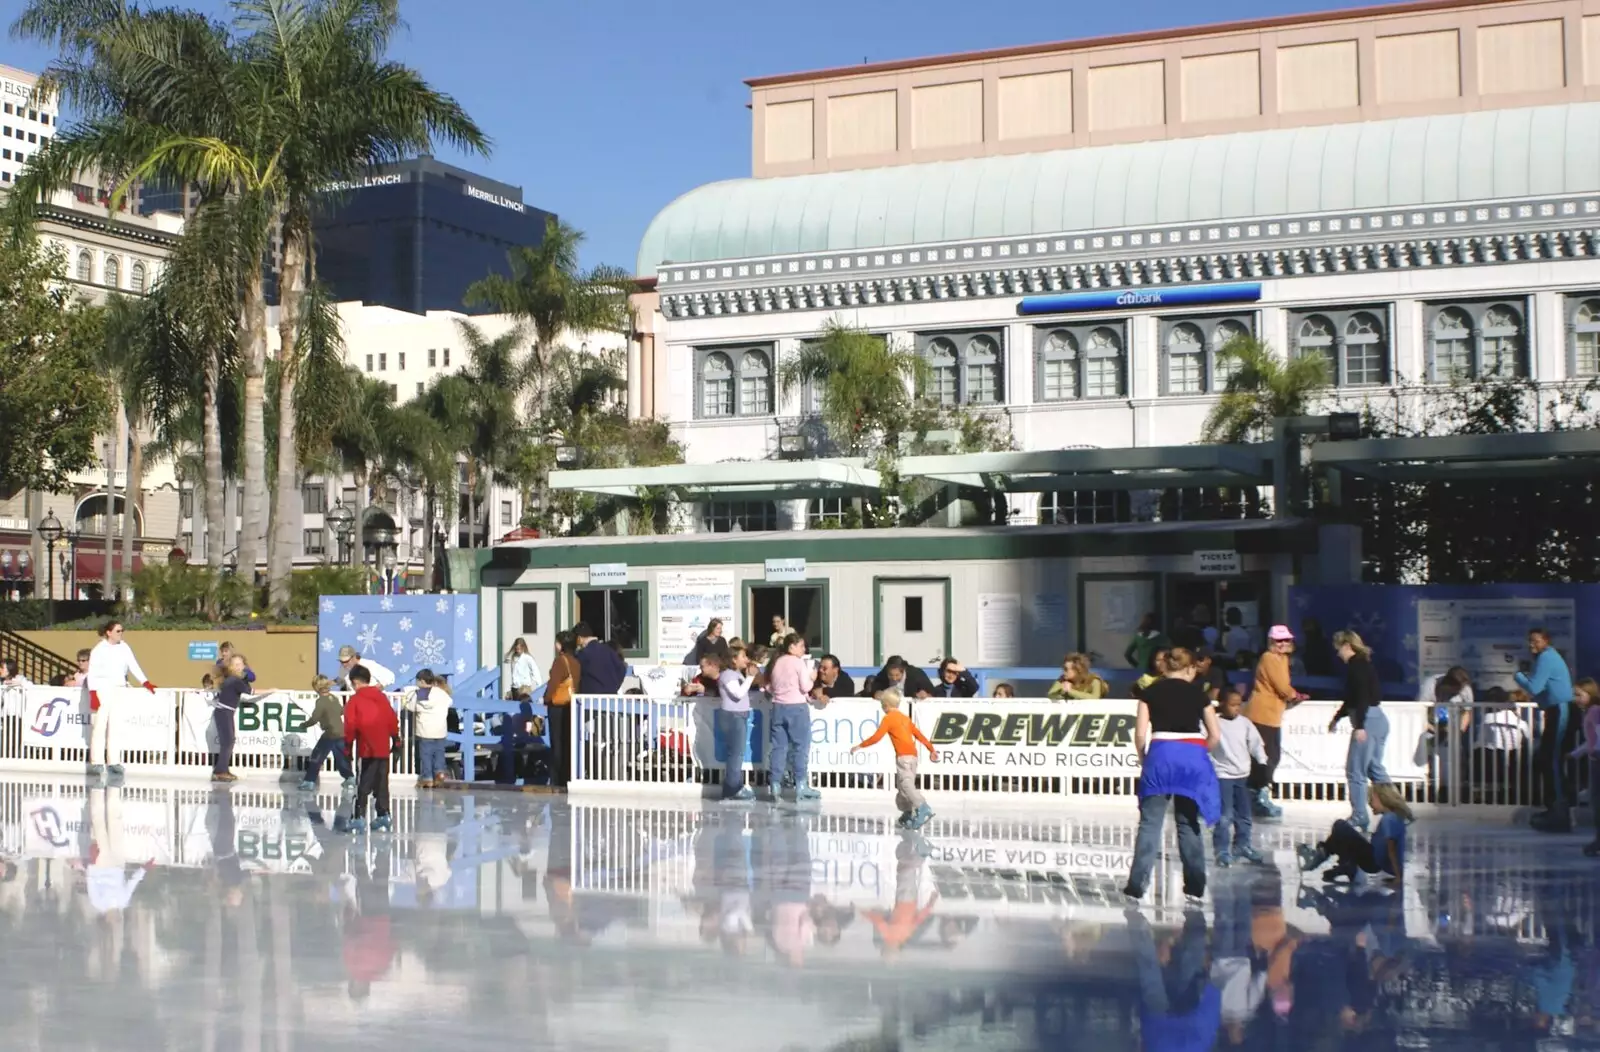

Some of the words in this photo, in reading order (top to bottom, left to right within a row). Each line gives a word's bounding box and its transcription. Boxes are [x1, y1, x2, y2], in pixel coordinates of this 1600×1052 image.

[364, 174, 401, 187] LYNCH
[467, 185, 499, 205] MERRILL
[500, 195, 524, 213] LYNCH
[1115, 290, 1162, 305] citibank
[930, 711, 1138, 748] BREWER
[828, 750, 879, 766] union
[932, 750, 996, 765] CRANE
[1004, 751, 1047, 767] AND
[1055, 752, 1140, 768] RIGGING
